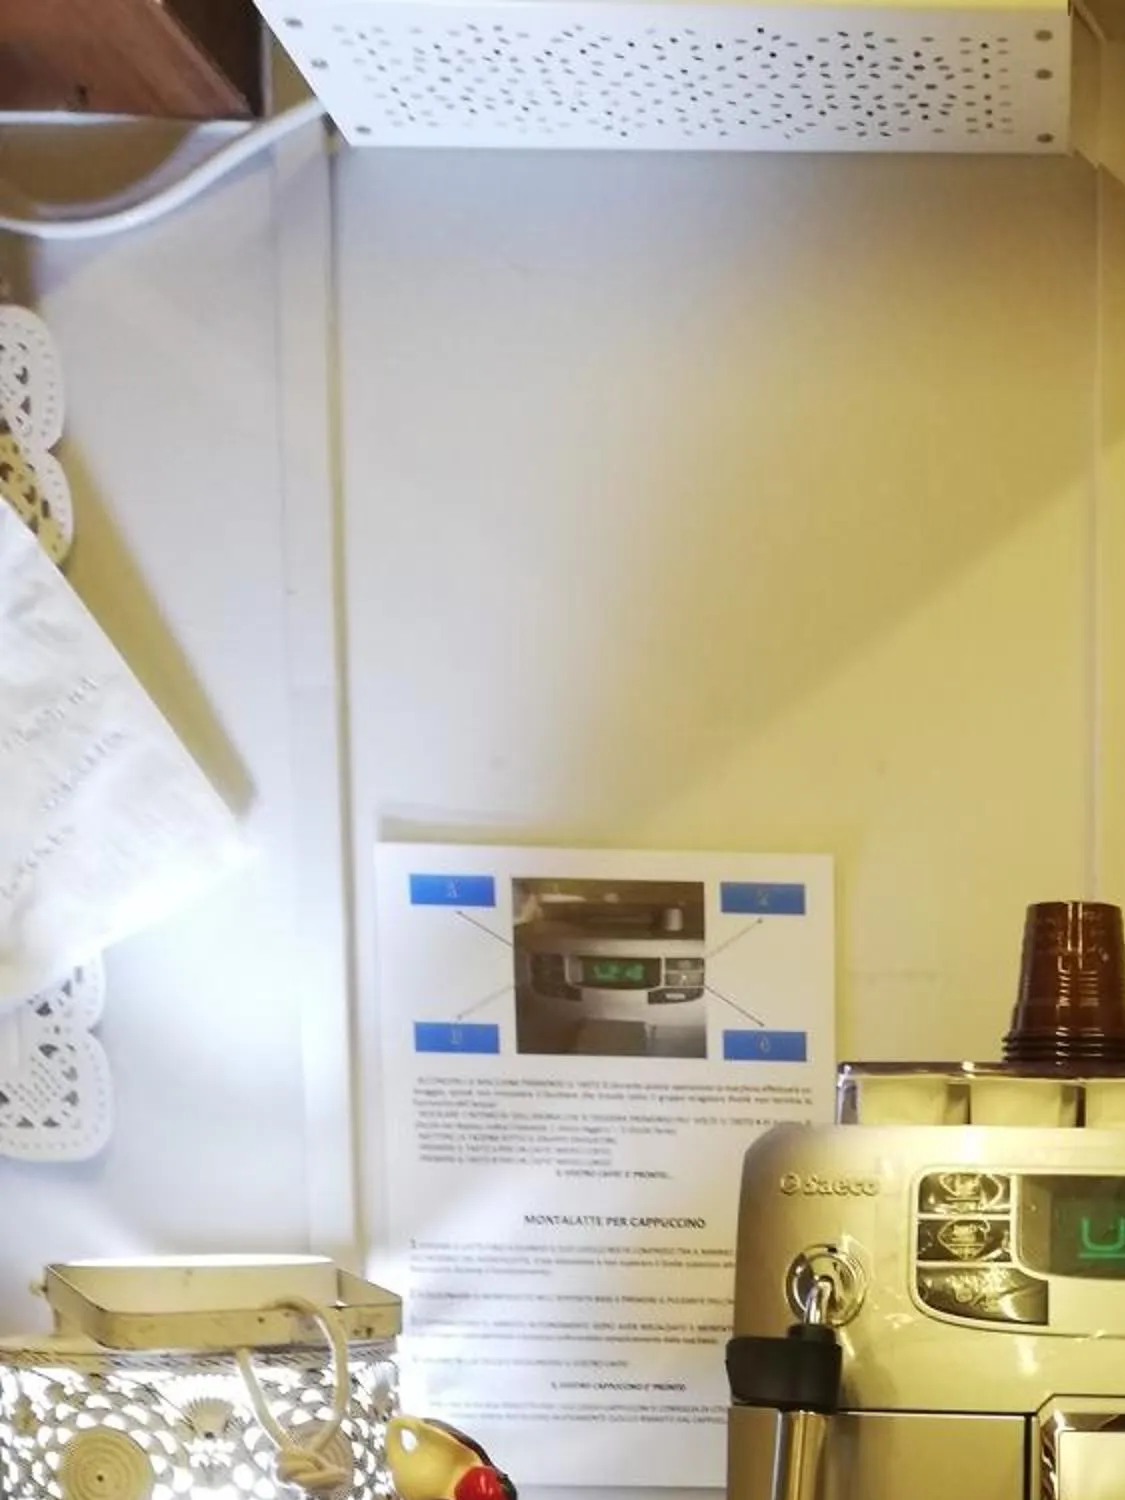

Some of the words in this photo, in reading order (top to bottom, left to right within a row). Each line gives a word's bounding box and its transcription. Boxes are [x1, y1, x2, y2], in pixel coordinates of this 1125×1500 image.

[524, 1214, 601, 1227] MONTALATTE
[605, 1216, 628, 1228] PER
[630, 1217, 707, 1230] CAPPUCCINO
